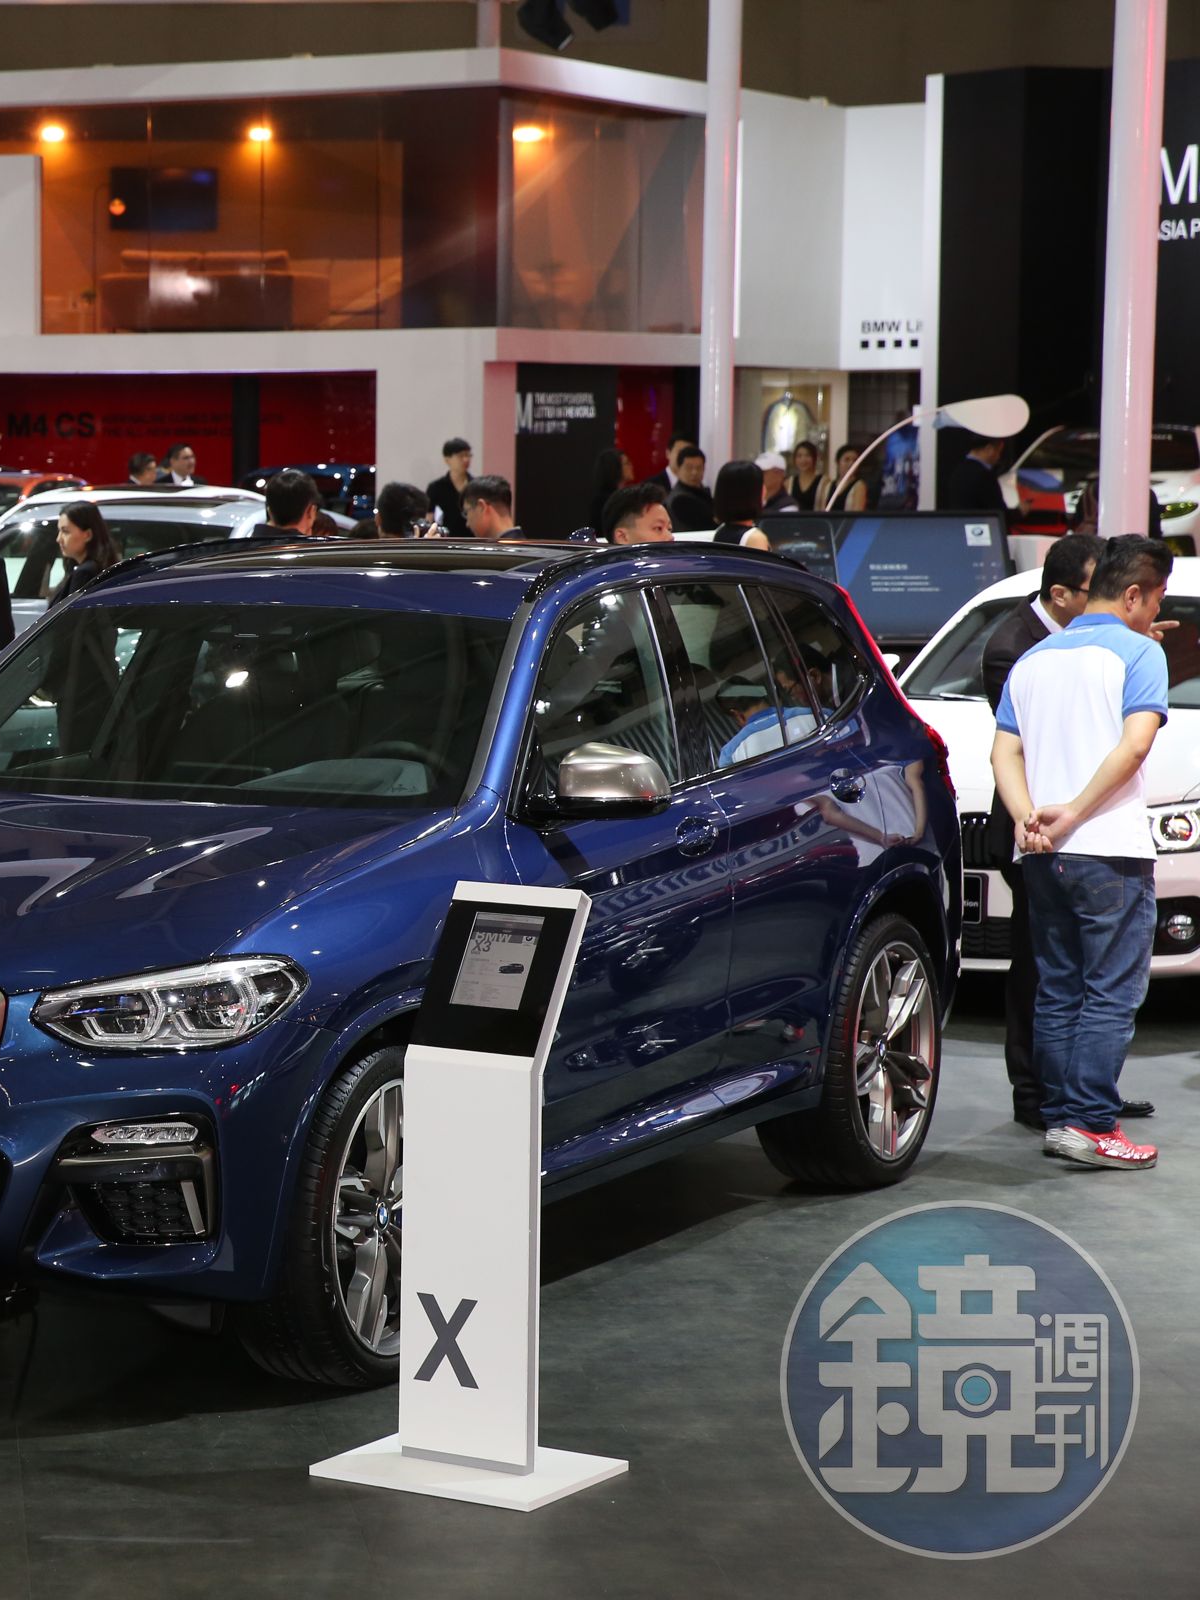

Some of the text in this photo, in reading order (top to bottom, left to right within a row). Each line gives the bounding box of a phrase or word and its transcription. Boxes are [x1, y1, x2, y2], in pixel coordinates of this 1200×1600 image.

[1159, 219, 1189, 241] SIA
[7, 412, 48, 438] M4
[55, 412, 96, 438] CS
[471, 940, 492, 953] X3
[413, 1291, 480, 1390] X
